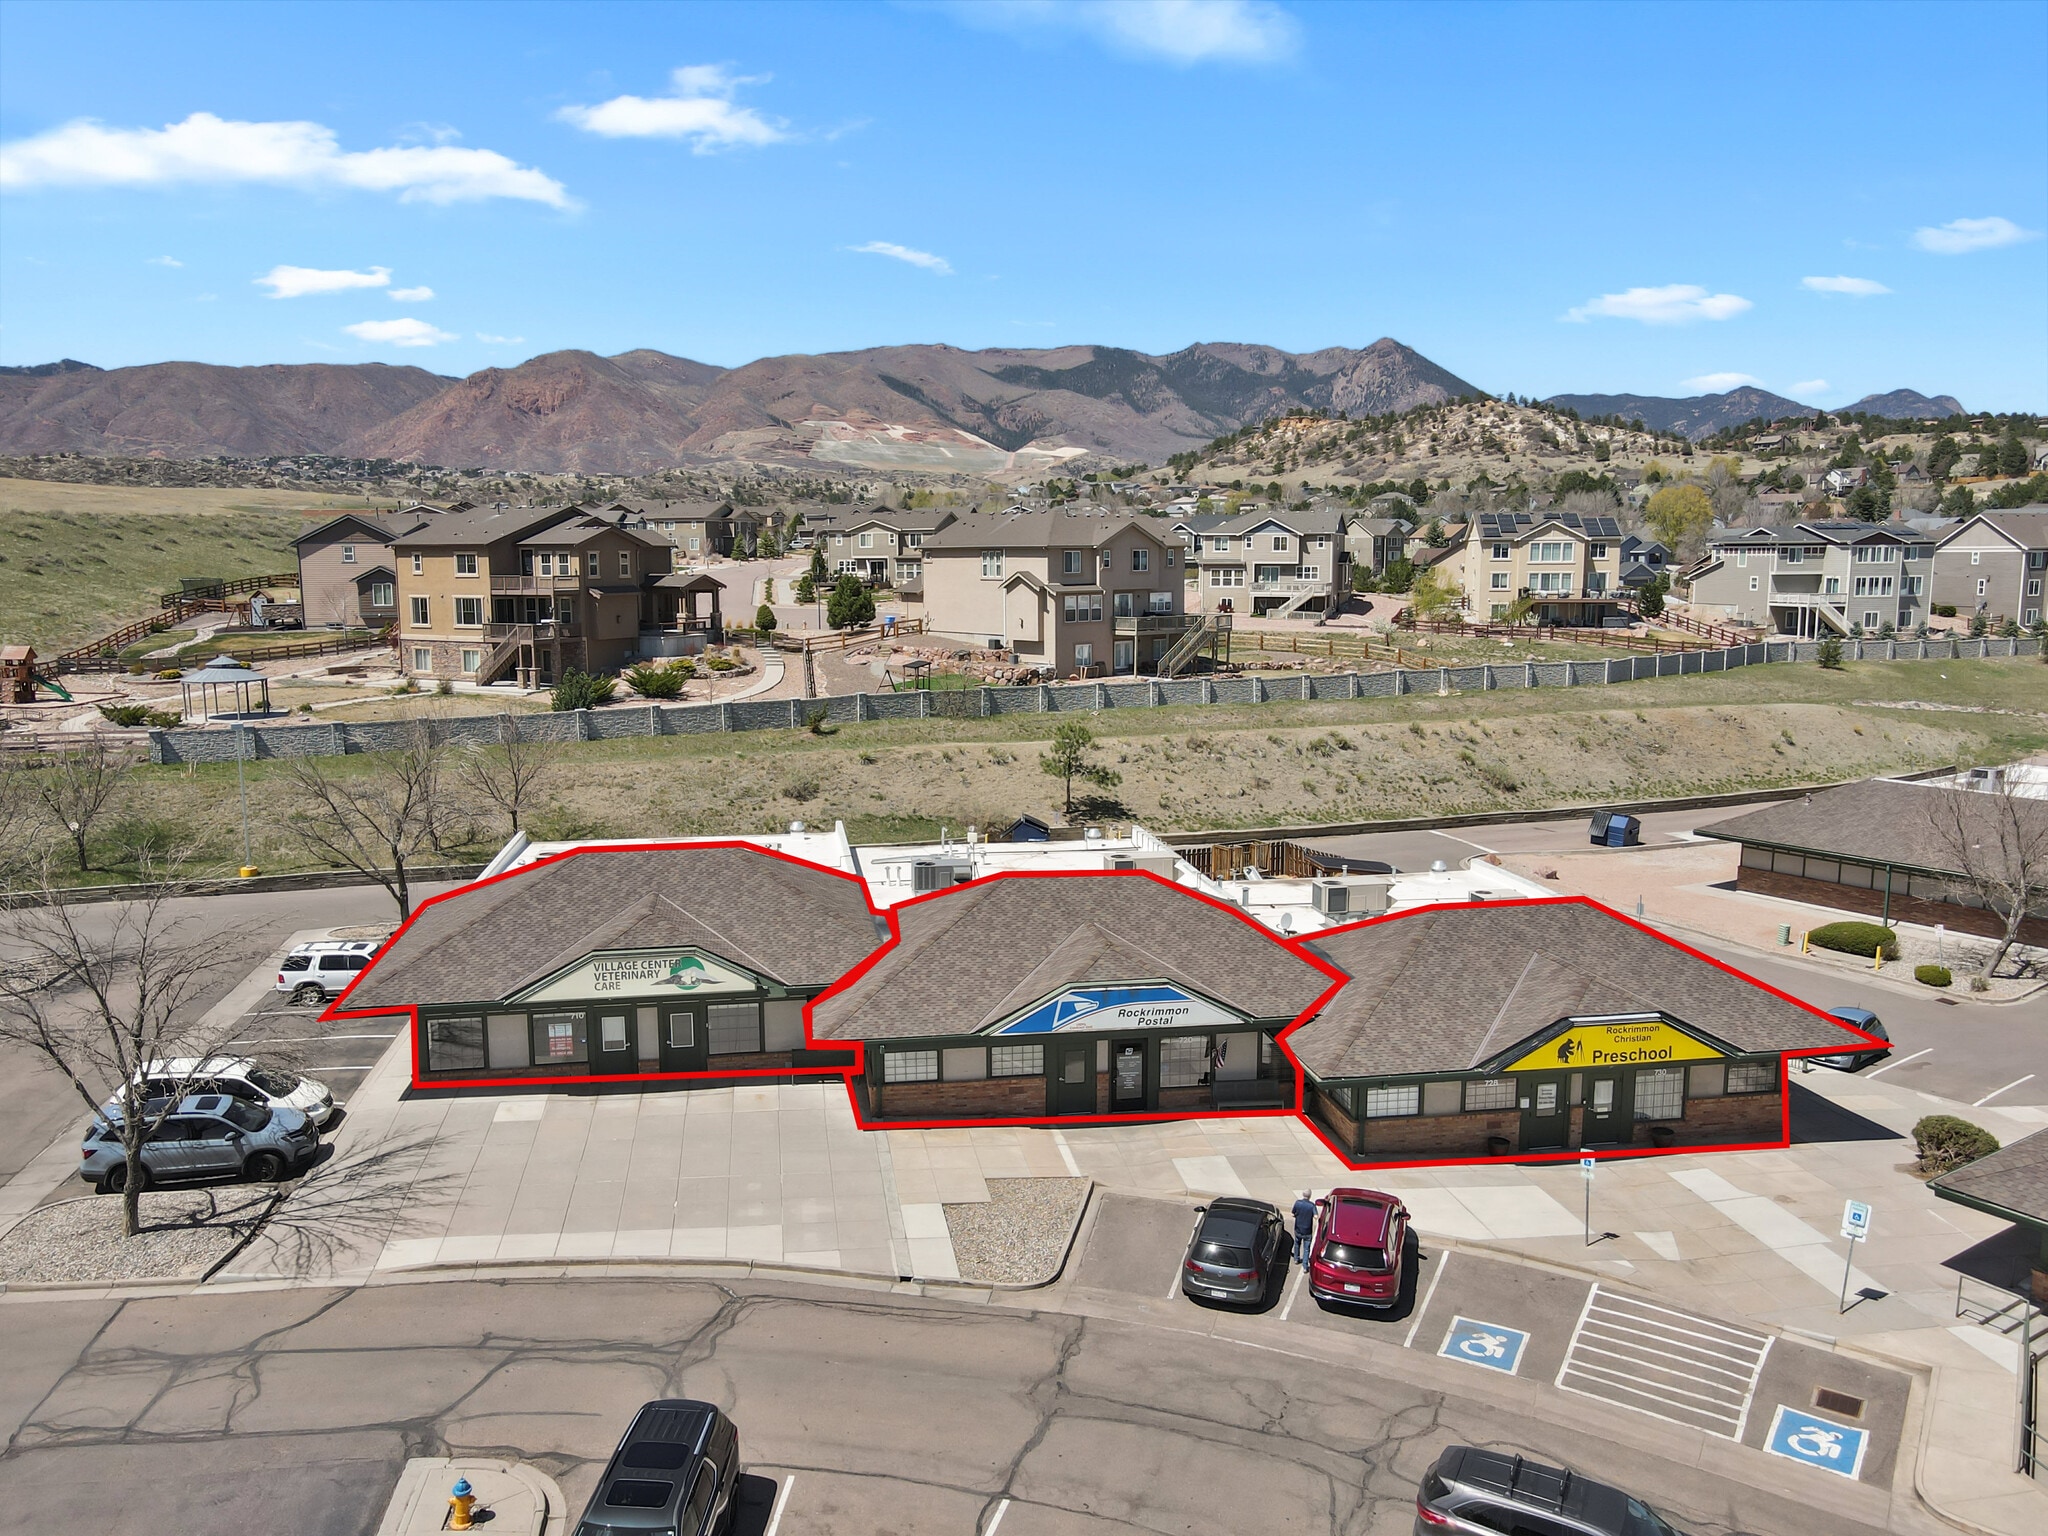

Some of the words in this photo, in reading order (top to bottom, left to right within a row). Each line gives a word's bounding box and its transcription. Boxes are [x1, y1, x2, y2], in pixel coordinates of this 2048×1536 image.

[593, 960, 638, 972] VILLAGE
[640, 959, 682, 970] CENTER
[593, 969, 661, 981] VETERINARY
[594, 981, 621, 991] CARE
[570, 1012, 585, 1020] 710
[1117, 1007, 1189, 1018] Rockrimmon
[1137, 1016, 1174, 1026] Postal
[1606, 1025, 1660, 1034] Rockrimmon
[1613, 1034, 1652, 1043] Christian
[1592, 1045, 1673, 1063] Preschool
